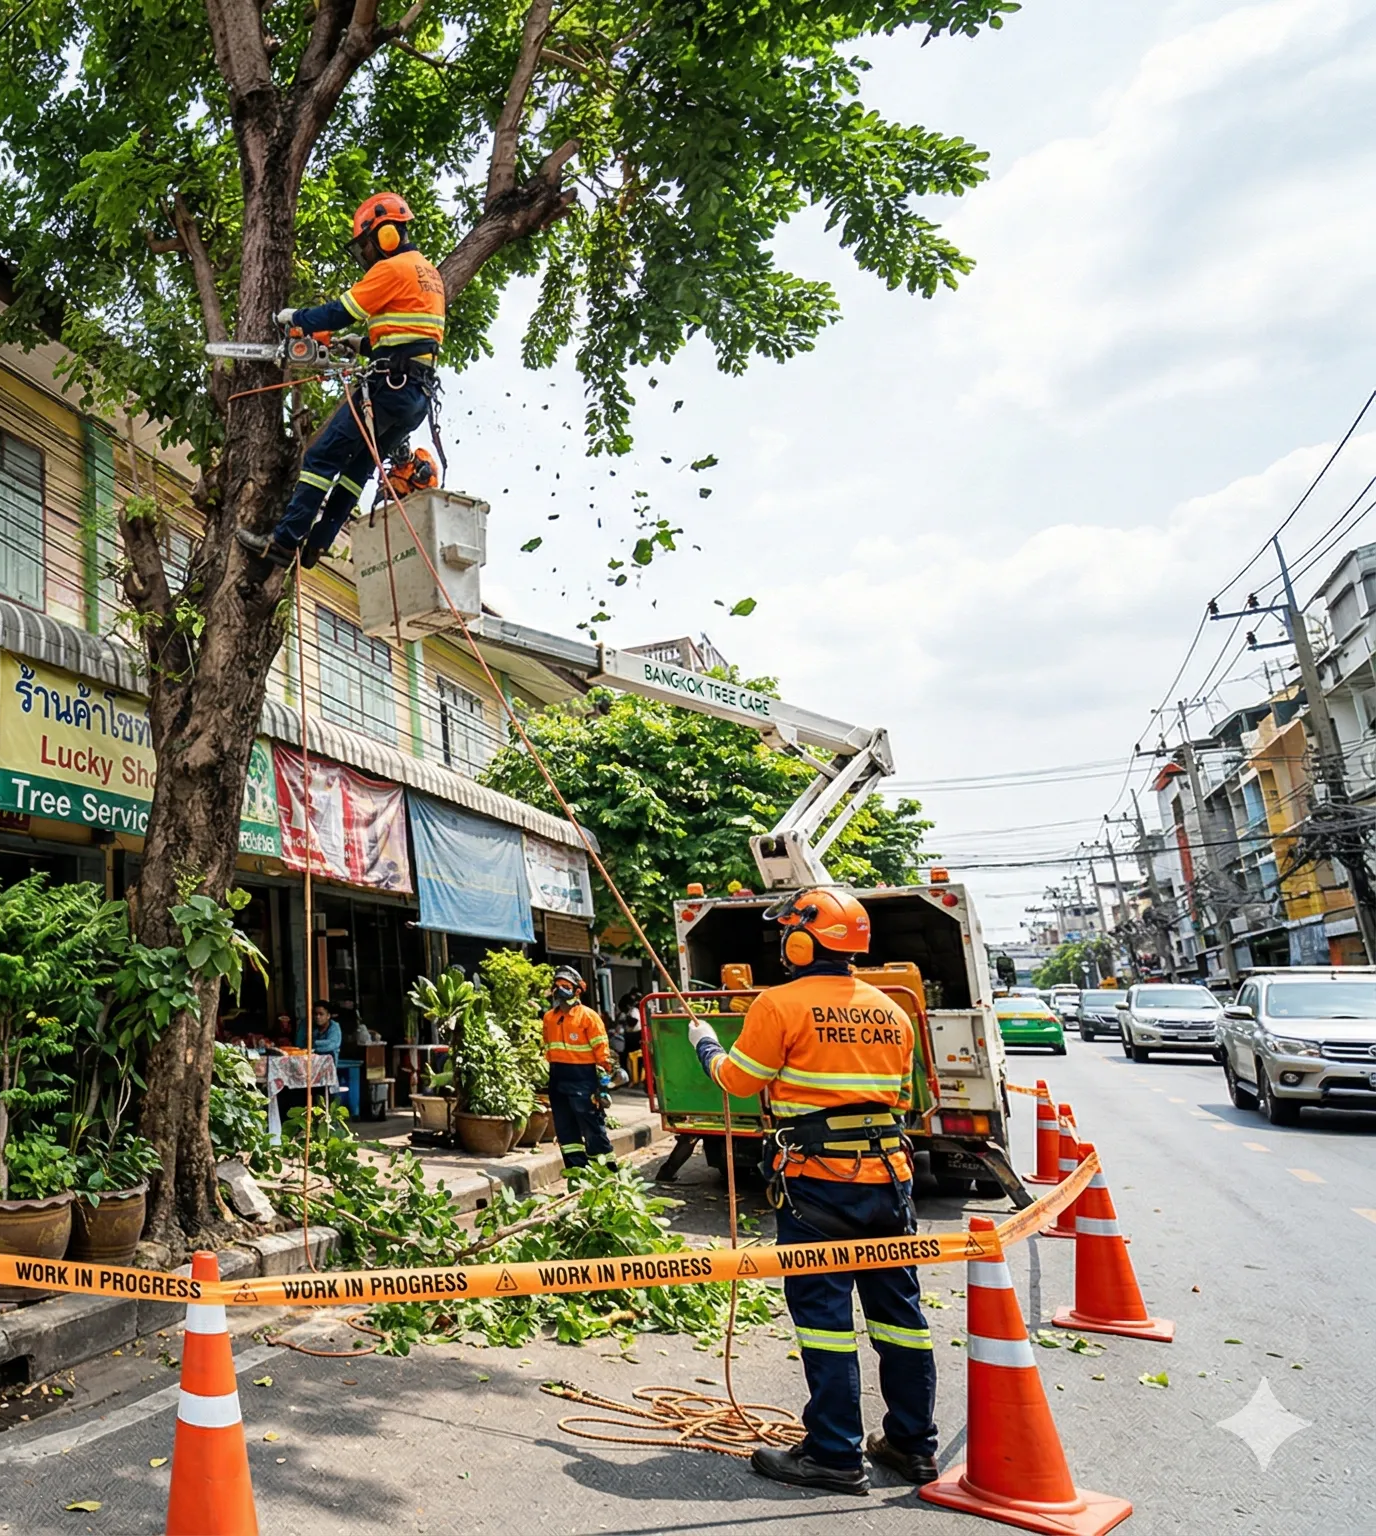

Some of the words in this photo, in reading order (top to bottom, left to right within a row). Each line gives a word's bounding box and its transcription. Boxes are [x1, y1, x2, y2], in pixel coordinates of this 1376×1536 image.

[644, 664, 705, 697] BANGKOK
[707, 683, 736, 706] TREE
[40, 735, 114, 786] Lucky
[12, 778, 71, 816] Tree
[82, 793, 149, 833] Servic
[812, 1007, 898, 1025] BANGKOK
[815, 1027, 857, 1043] TREE
[861, 1028, 902, 1045] CARE
[15, 1262, 69, 1285] WORK
[75, 1267, 92, 1288] IN
[100, 1271, 201, 1299] PROGRESS
[282, 1279, 339, 1299] WORK
[345, 1277, 363, 1297] IN
[371, 1272, 468, 1296] PROGRESS
[538, 1265, 592, 1286] WORK
[597, 1264, 615, 1283] IN
[621, 1257, 712, 1281] PROGRESS
[777, 1249, 828, 1269] WORK
[832, 1246, 849, 1265] IN
[856, 1239, 940, 1264] PROGRESS
